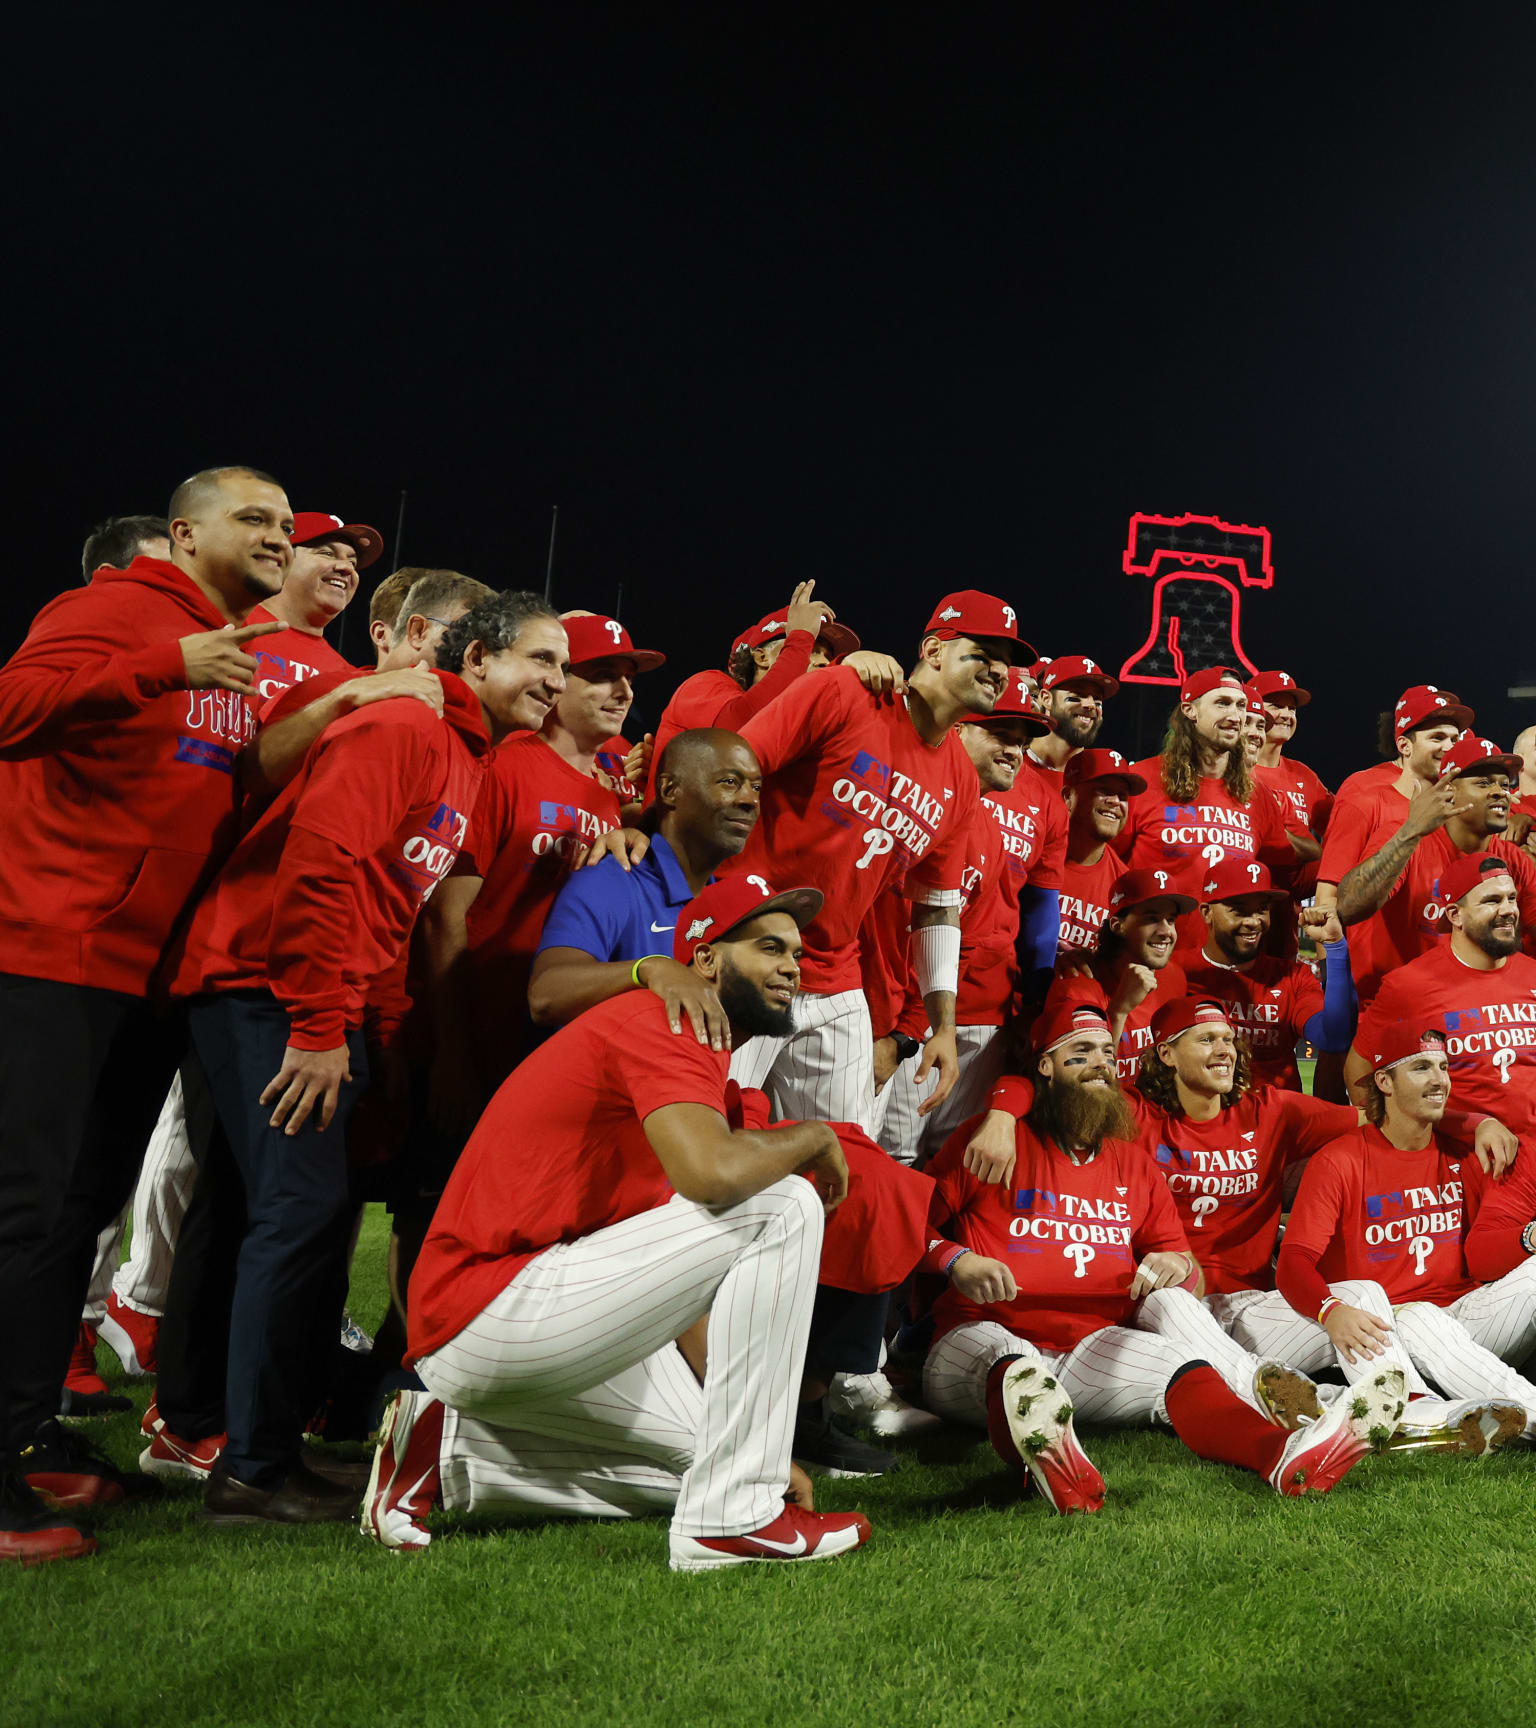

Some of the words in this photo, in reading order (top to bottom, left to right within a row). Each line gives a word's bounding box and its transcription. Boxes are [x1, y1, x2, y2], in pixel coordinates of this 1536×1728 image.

[891, 770, 945, 831] TAKE
[1287, 791, 1307, 808] KE
[832, 777, 931, 857] OCTOBER
[1197, 805, 1251, 833] TAKE
[855, 827, 895, 869] P
[1160, 826, 1254, 854] OCTOBER
[1058, 895, 1110, 927] TAK
[1229, 1003, 1279, 1022] AKE
[1131, 1025, 1155, 1049] TA
[1491, 1048, 1516, 1084] P
[1192, 1148, 1259, 1173] TAKE
[1165, 1171, 1259, 1197] CTOBER
[1404, 1180, 1464, 1210] TAKE
[1059, 1193, 1131, 1222] TAKE
[1191, 1195, 1219, 1228] P
[1364, 1206, 1461, 1246] OCTOBE
[1062, 1243, 1095, 1278] P
[1408, 1235, 1434, 1276] P
